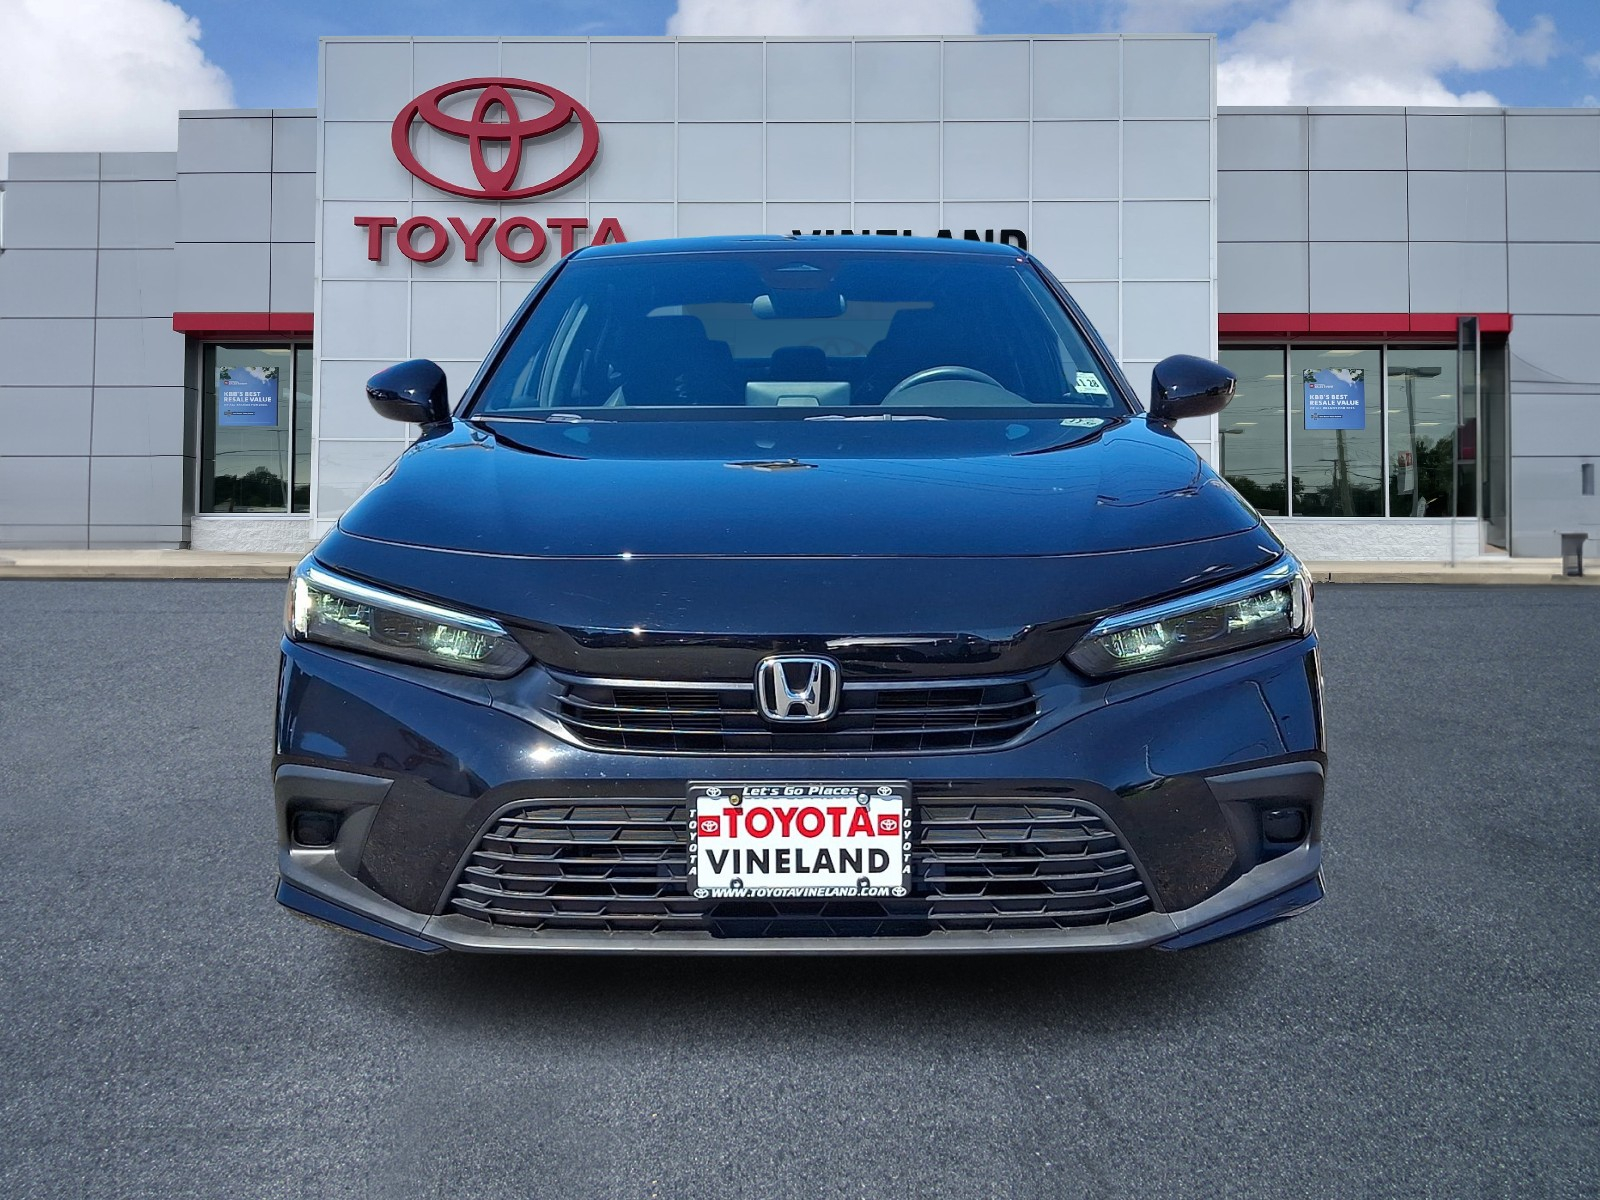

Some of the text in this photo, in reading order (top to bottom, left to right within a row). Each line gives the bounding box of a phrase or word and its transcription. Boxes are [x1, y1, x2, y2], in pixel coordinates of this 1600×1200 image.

[354, 216, 628, 263] TOYOTA
[742, 786, 859, 796] Let's Go Places
[723, 806, 875, 838] TOYOTA
[705, 848, 891, 875] VINELAND
[711, 887, 890, 898] WWW.TOYOTAVINELAND.COM
